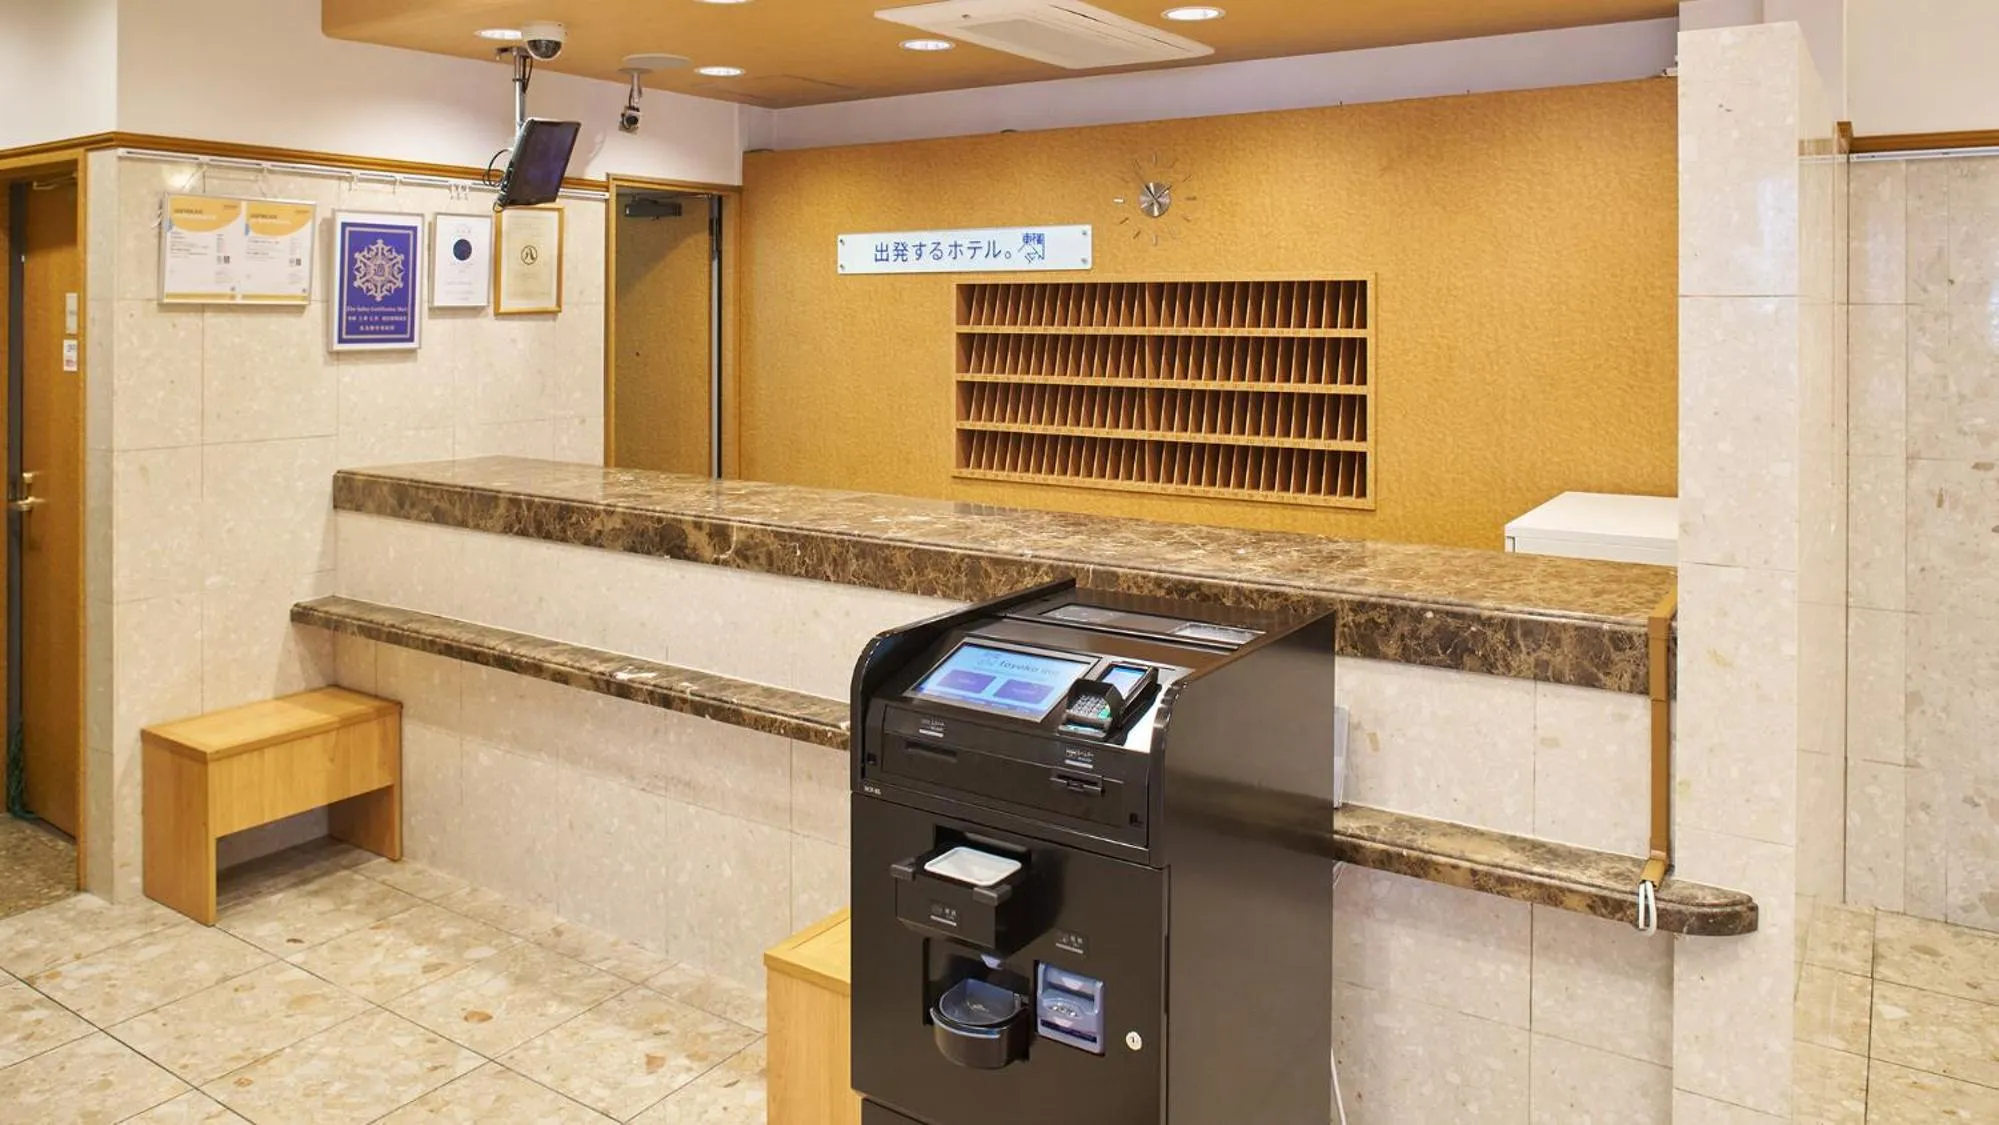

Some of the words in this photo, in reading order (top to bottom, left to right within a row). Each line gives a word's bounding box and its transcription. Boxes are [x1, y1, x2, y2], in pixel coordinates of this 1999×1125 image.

[874, 240, 1011, 262] 出発するホテル。
